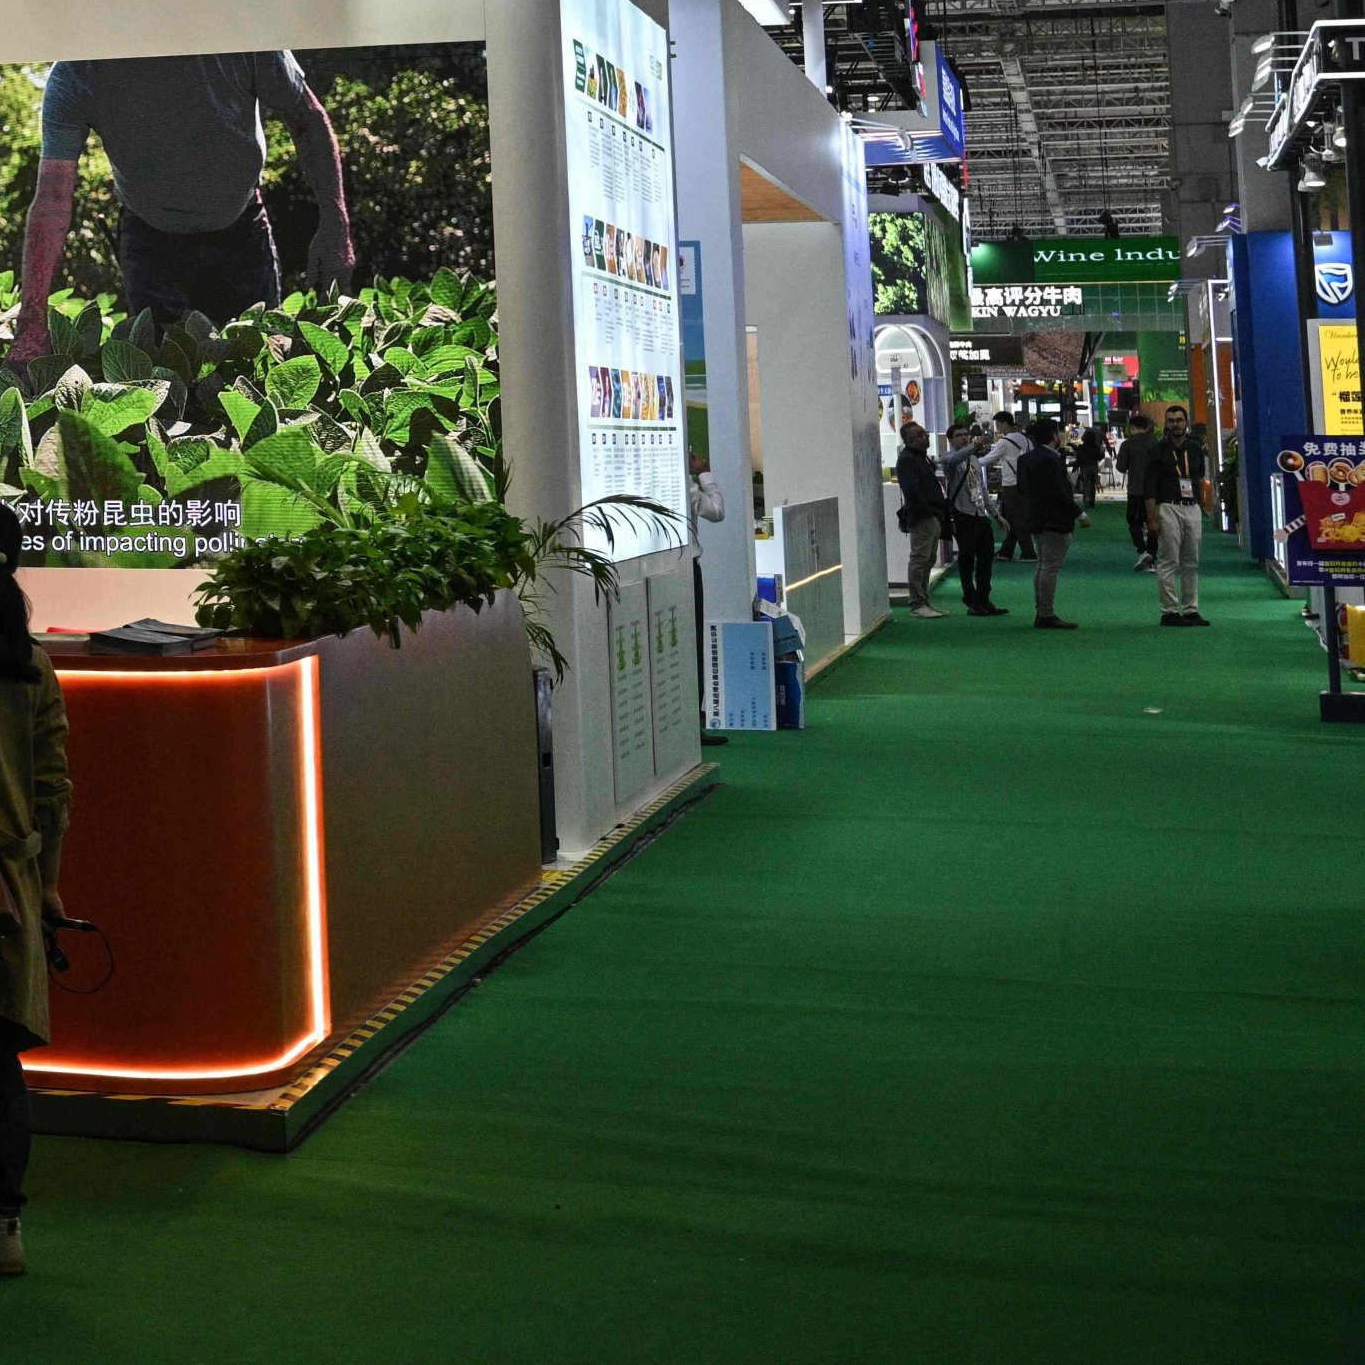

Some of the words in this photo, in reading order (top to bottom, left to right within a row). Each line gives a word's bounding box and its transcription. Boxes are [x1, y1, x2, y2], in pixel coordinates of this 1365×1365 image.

[1033, 249, 1105, 263] Wine
[971, 285, 1082, 307] 最高评分牛肉
[1005, 305, 1062, 318] WAGYU
[51, 530, 74, 552] of
[80, 532, 188, 558] impacting
